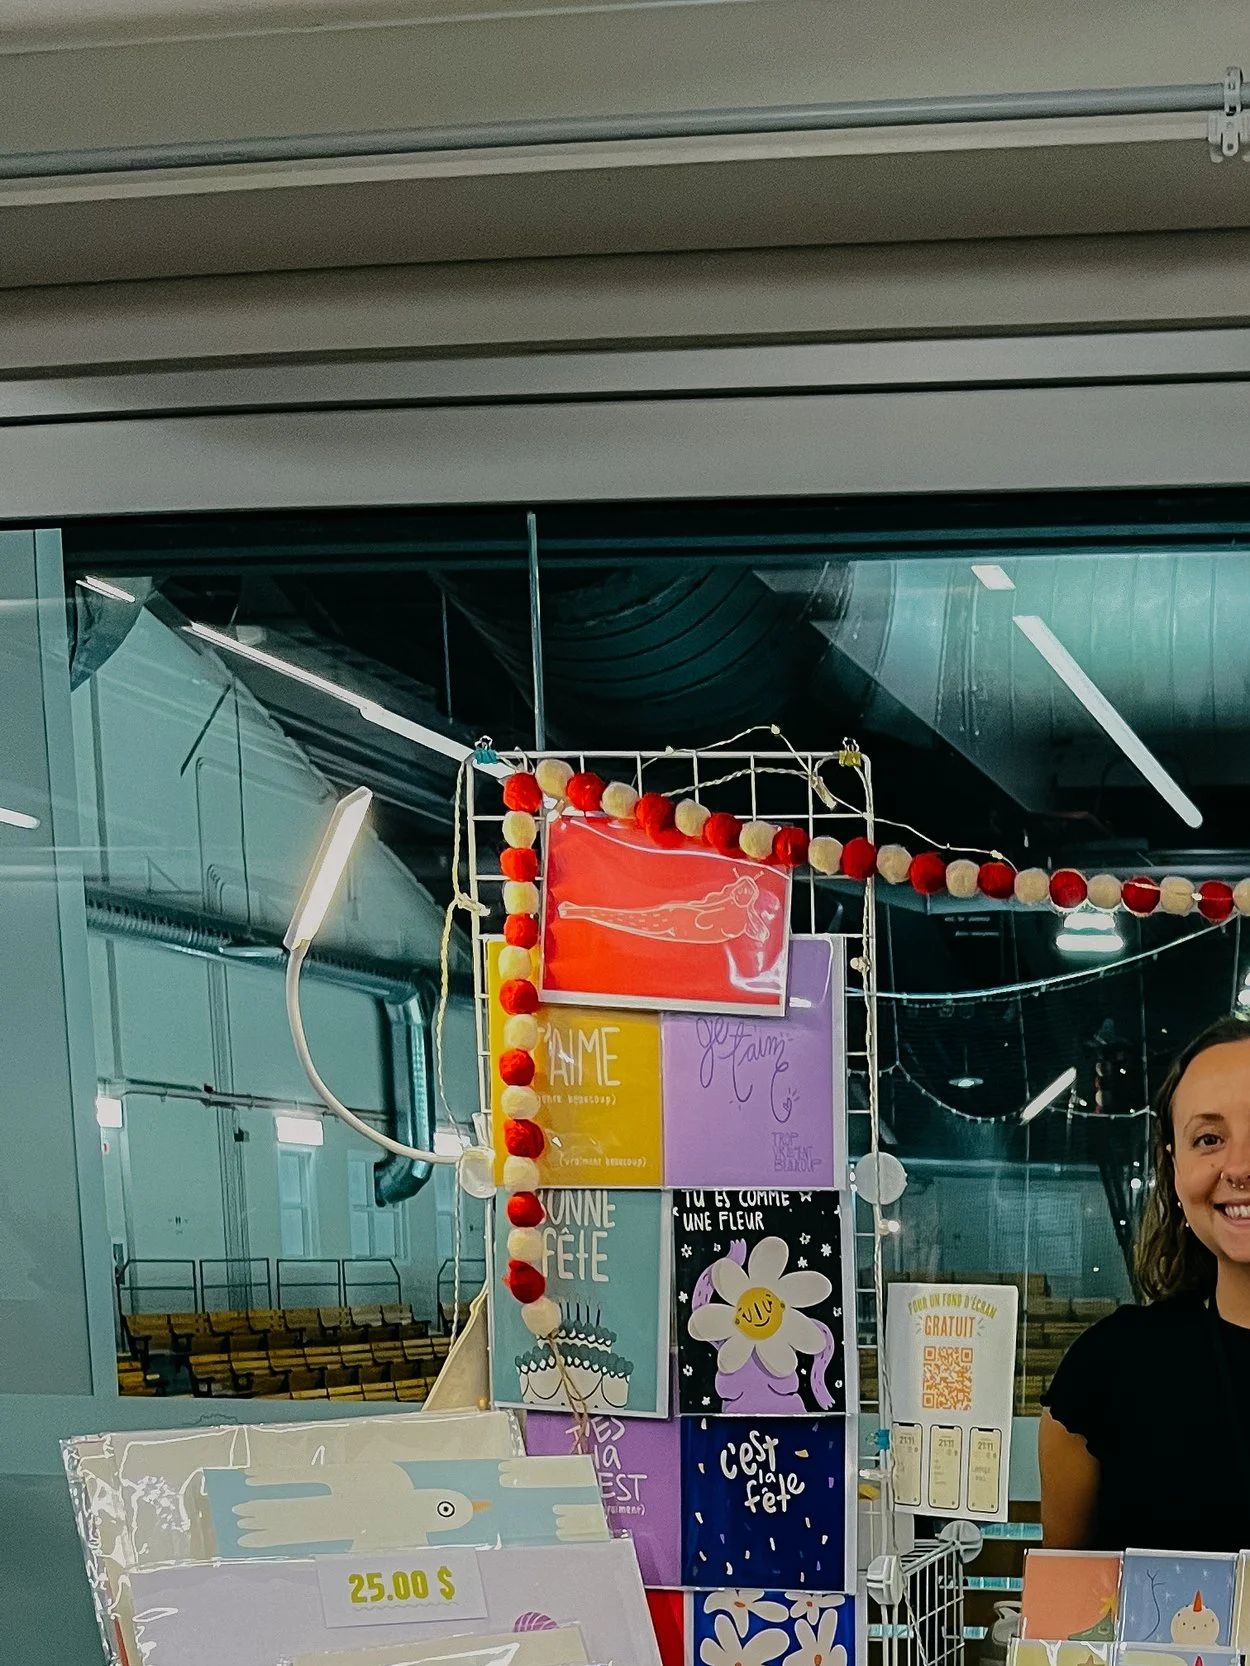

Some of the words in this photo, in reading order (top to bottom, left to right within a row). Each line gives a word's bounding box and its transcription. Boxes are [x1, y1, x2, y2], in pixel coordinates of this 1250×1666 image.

[541, 1190, 616, 1229] ONNE
[681, 1190, 705, 1208] TU
[714, 1190, 731, 1208] ES
[738, 1190, 791, 1208] COMME
[683, 1211, 713, 1232] UNE
[718, 1210, 765, 1232] FLEUR
[924, 1314, 976, 1338] GRATUIT
[597, 1471, 648, 1502] EST
[758, 1468, 776, 1484] la
[744, 1472, 806, 1514] fête
[348, 1570, 430, 1603] 25.00
[437, 1566, 456, 1600] $
